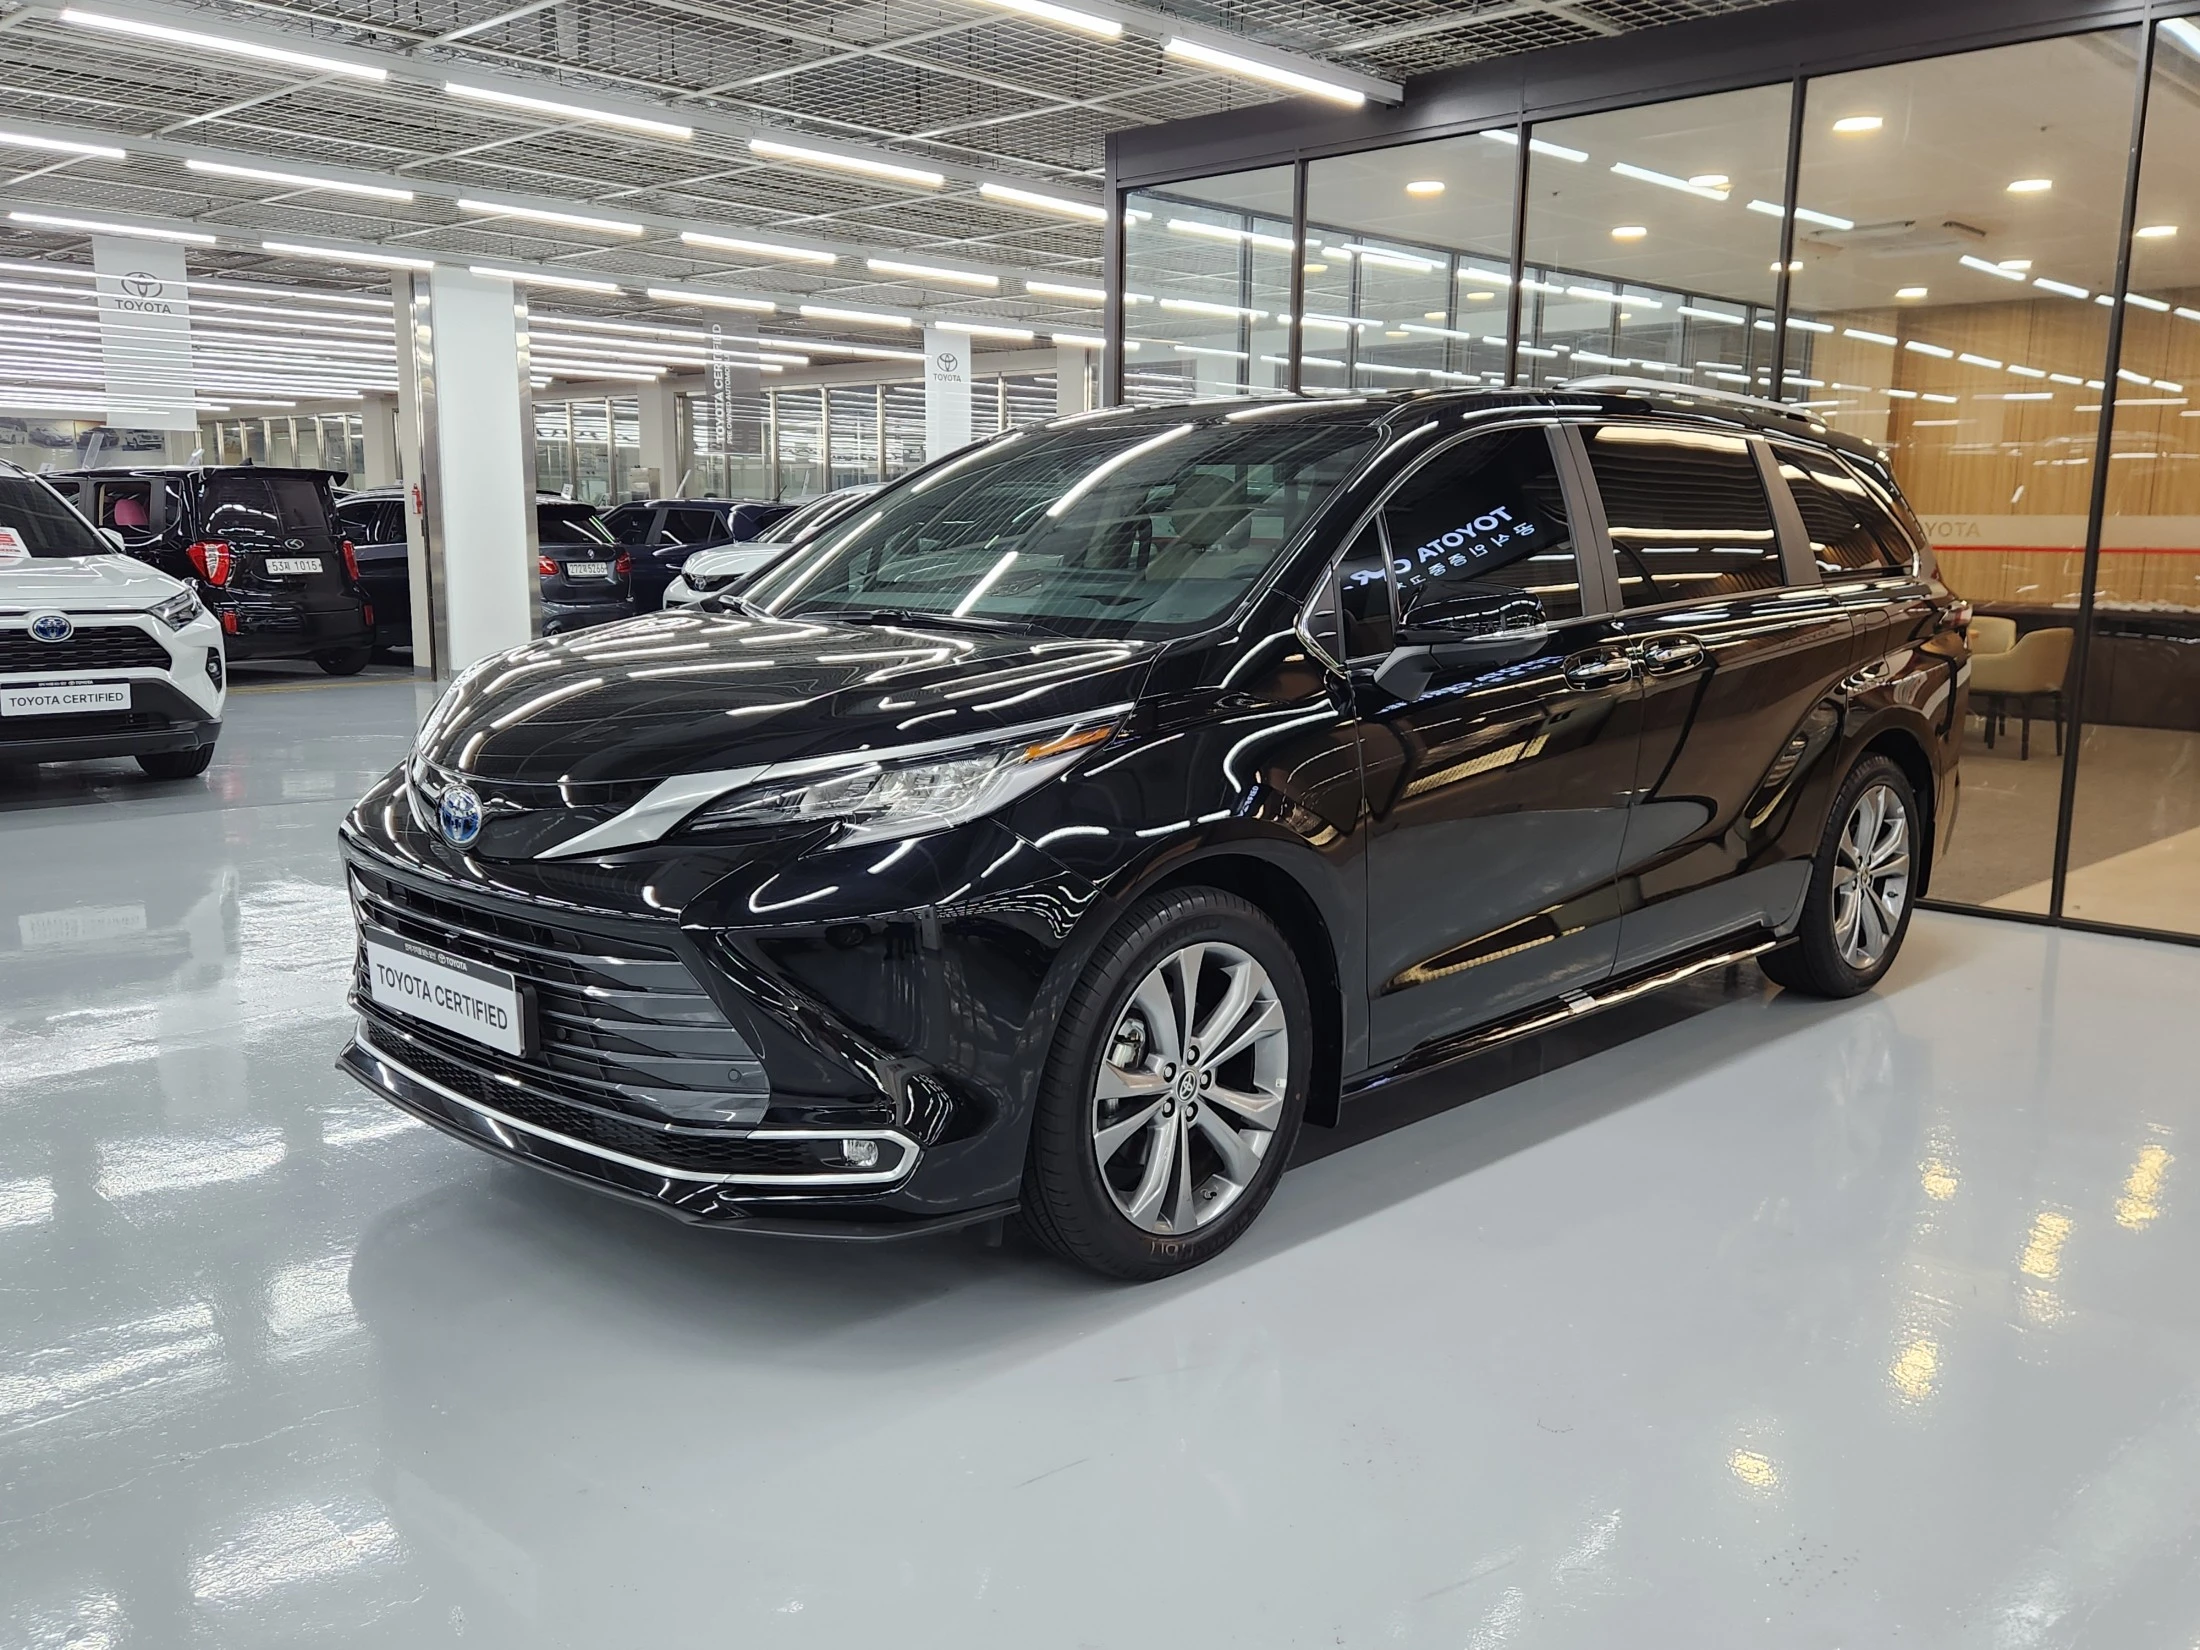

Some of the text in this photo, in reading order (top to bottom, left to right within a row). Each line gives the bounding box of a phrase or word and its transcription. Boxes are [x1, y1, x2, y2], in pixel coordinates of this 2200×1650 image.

[114, 299, 171, 314] TOYOTA
[723, 352, 732, 401] AUTOMOBLE
[932, 373, 962, 383] TOYOTA
[714, 392, 725, 444] TOYOTA
[725, 401, 733, 430] OWNED
[1924, 521, 1981, 537] YOTA
[294, 560, 318, 571] 1015
[9, 692, 124, 708] TOYOTA CERTIFIED
[446, 956, 468, 971] TOYOTA
[376, 963, 508, 1030] TOYOTA CERTIFIED
